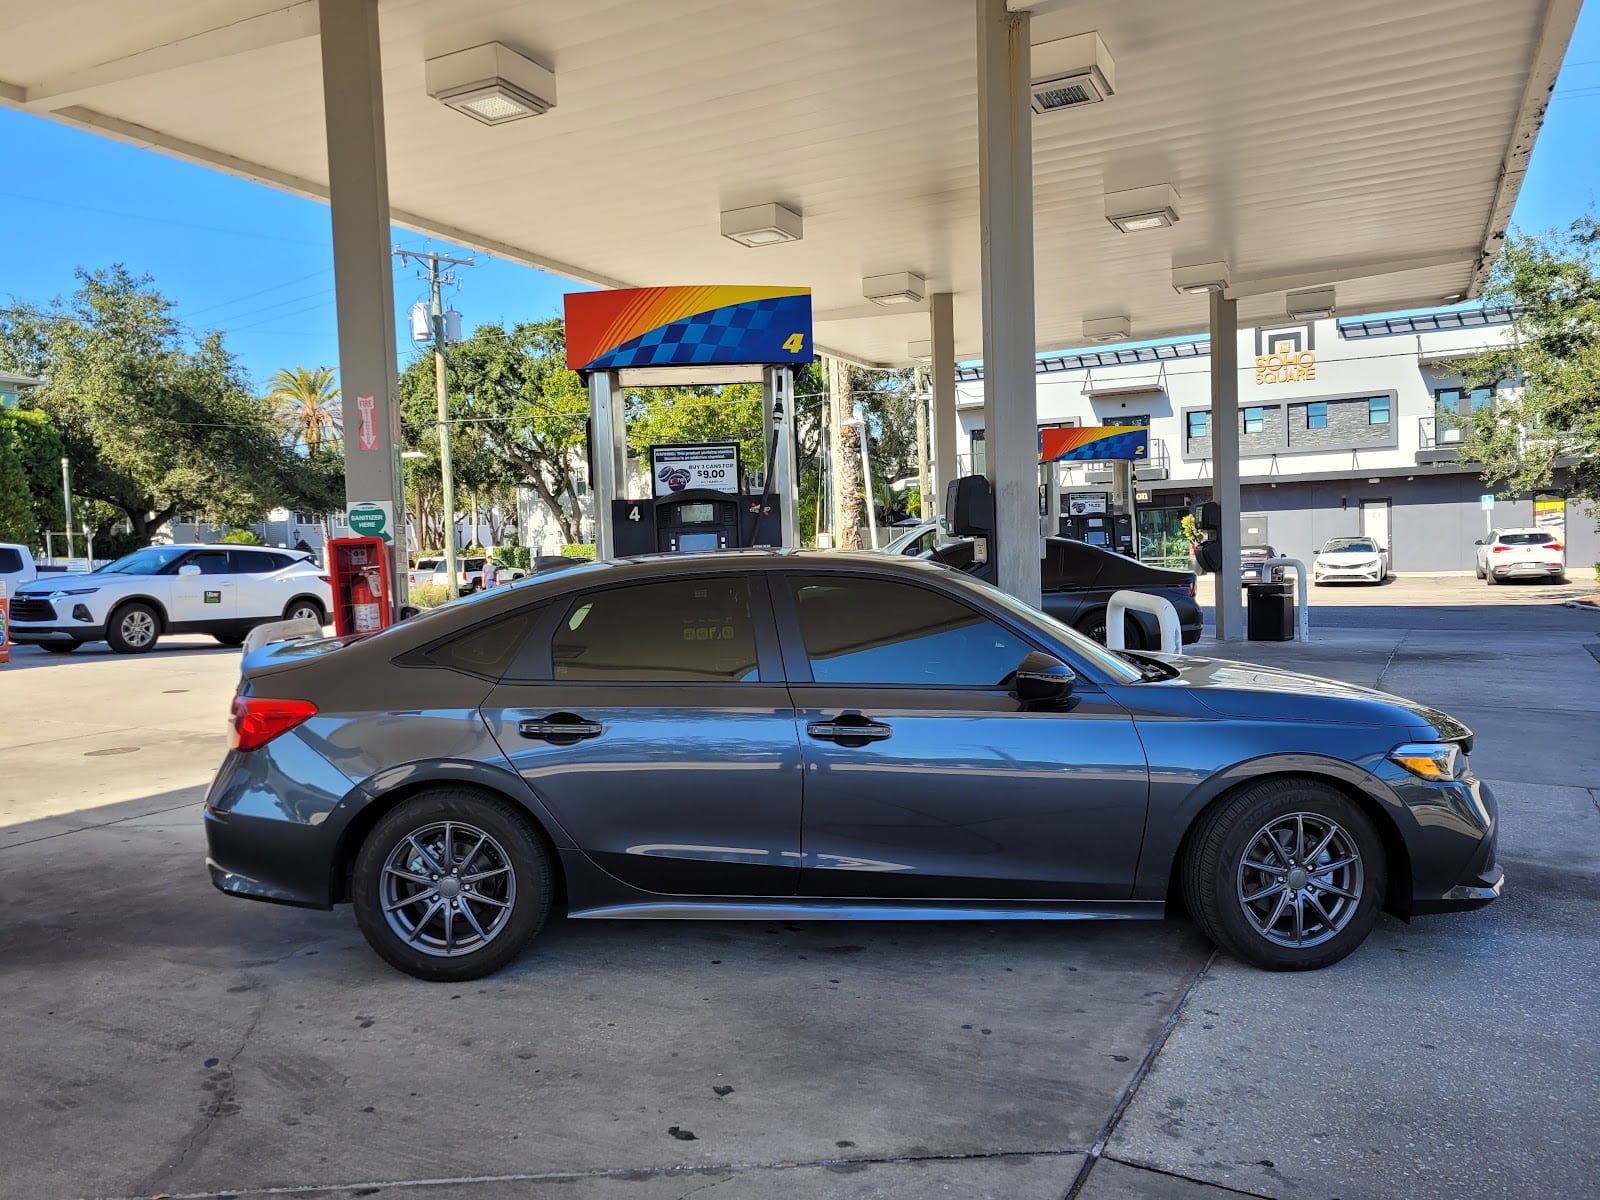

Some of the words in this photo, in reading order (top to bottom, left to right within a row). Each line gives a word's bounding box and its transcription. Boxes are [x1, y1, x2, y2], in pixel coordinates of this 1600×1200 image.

[782, 333, 804, 354] 4
[1255, 351, 1315, 373] SOHO
[1255, 368, 1315, 385] SQUARE
[360, 399, 372, 408] FIRE
[1135, 445, 1145, 455] 2
[697, 469, 725, 479] $9.00
[629, 506, 641, 522] 4
[359, 521, 376, 529] HERE
[1066, 519, 1072, 527] 2
